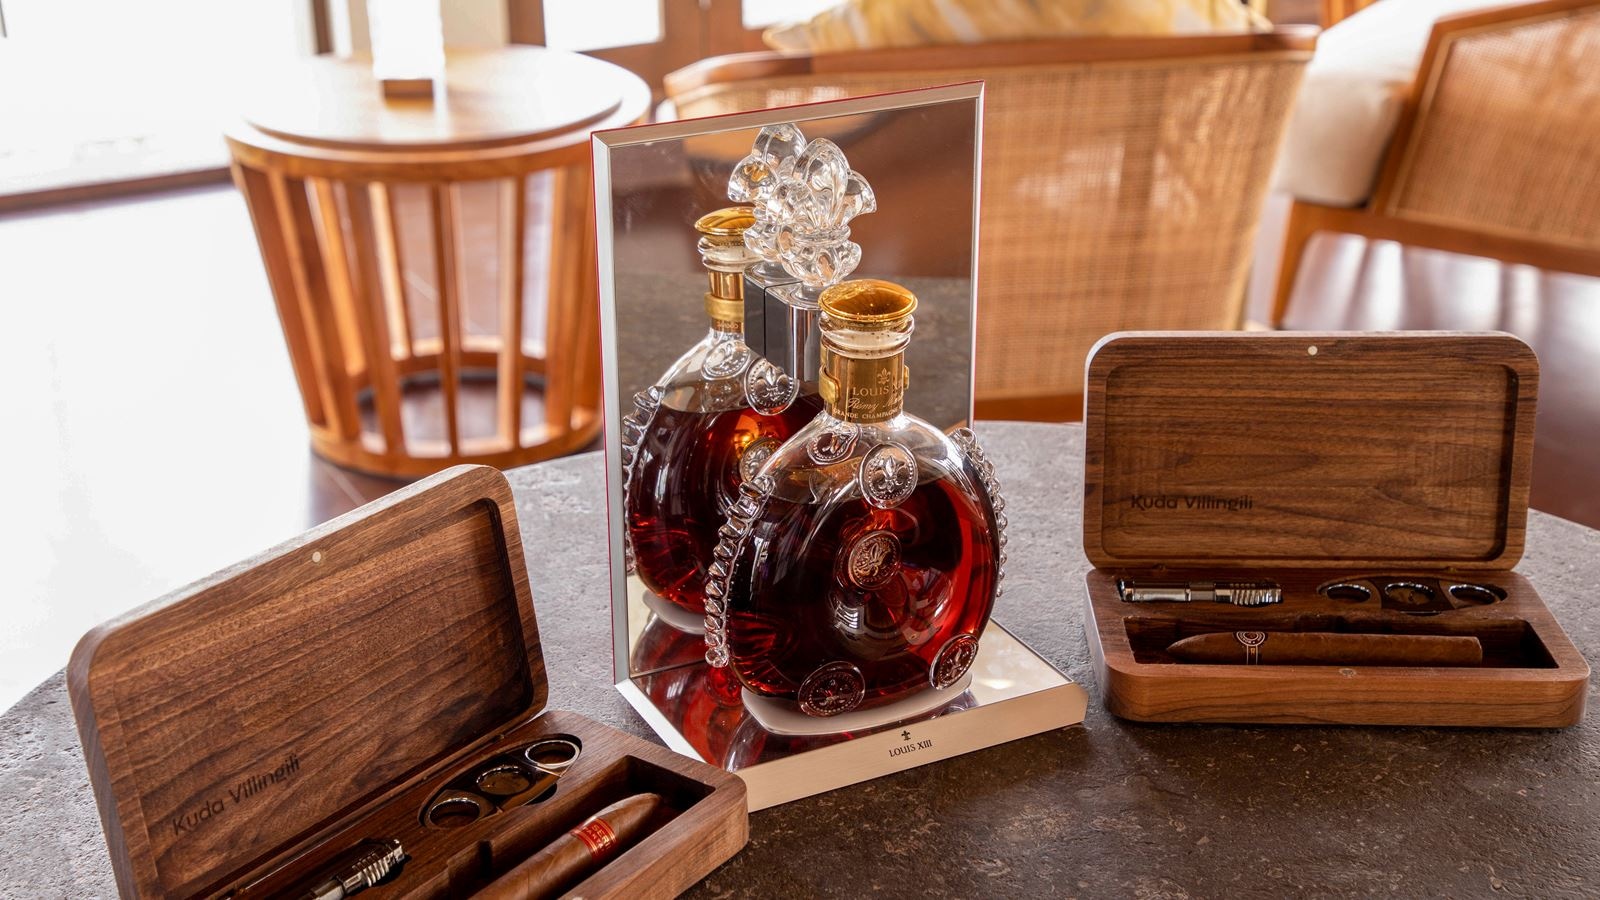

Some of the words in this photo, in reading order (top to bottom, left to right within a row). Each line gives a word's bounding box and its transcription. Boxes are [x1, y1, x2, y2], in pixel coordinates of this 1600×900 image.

[853, 386, 890, 397] LOUIS
[1131, 495, 1178, 511] Kuda
[1184, 495, 1253, 512] Villingili
[889, 744, 916, 757] LOUIS
[917, 739, 933, 751] XIII
[172, 799, 225, 836] Kuda
[228, 753, 300, 804] Villingili
